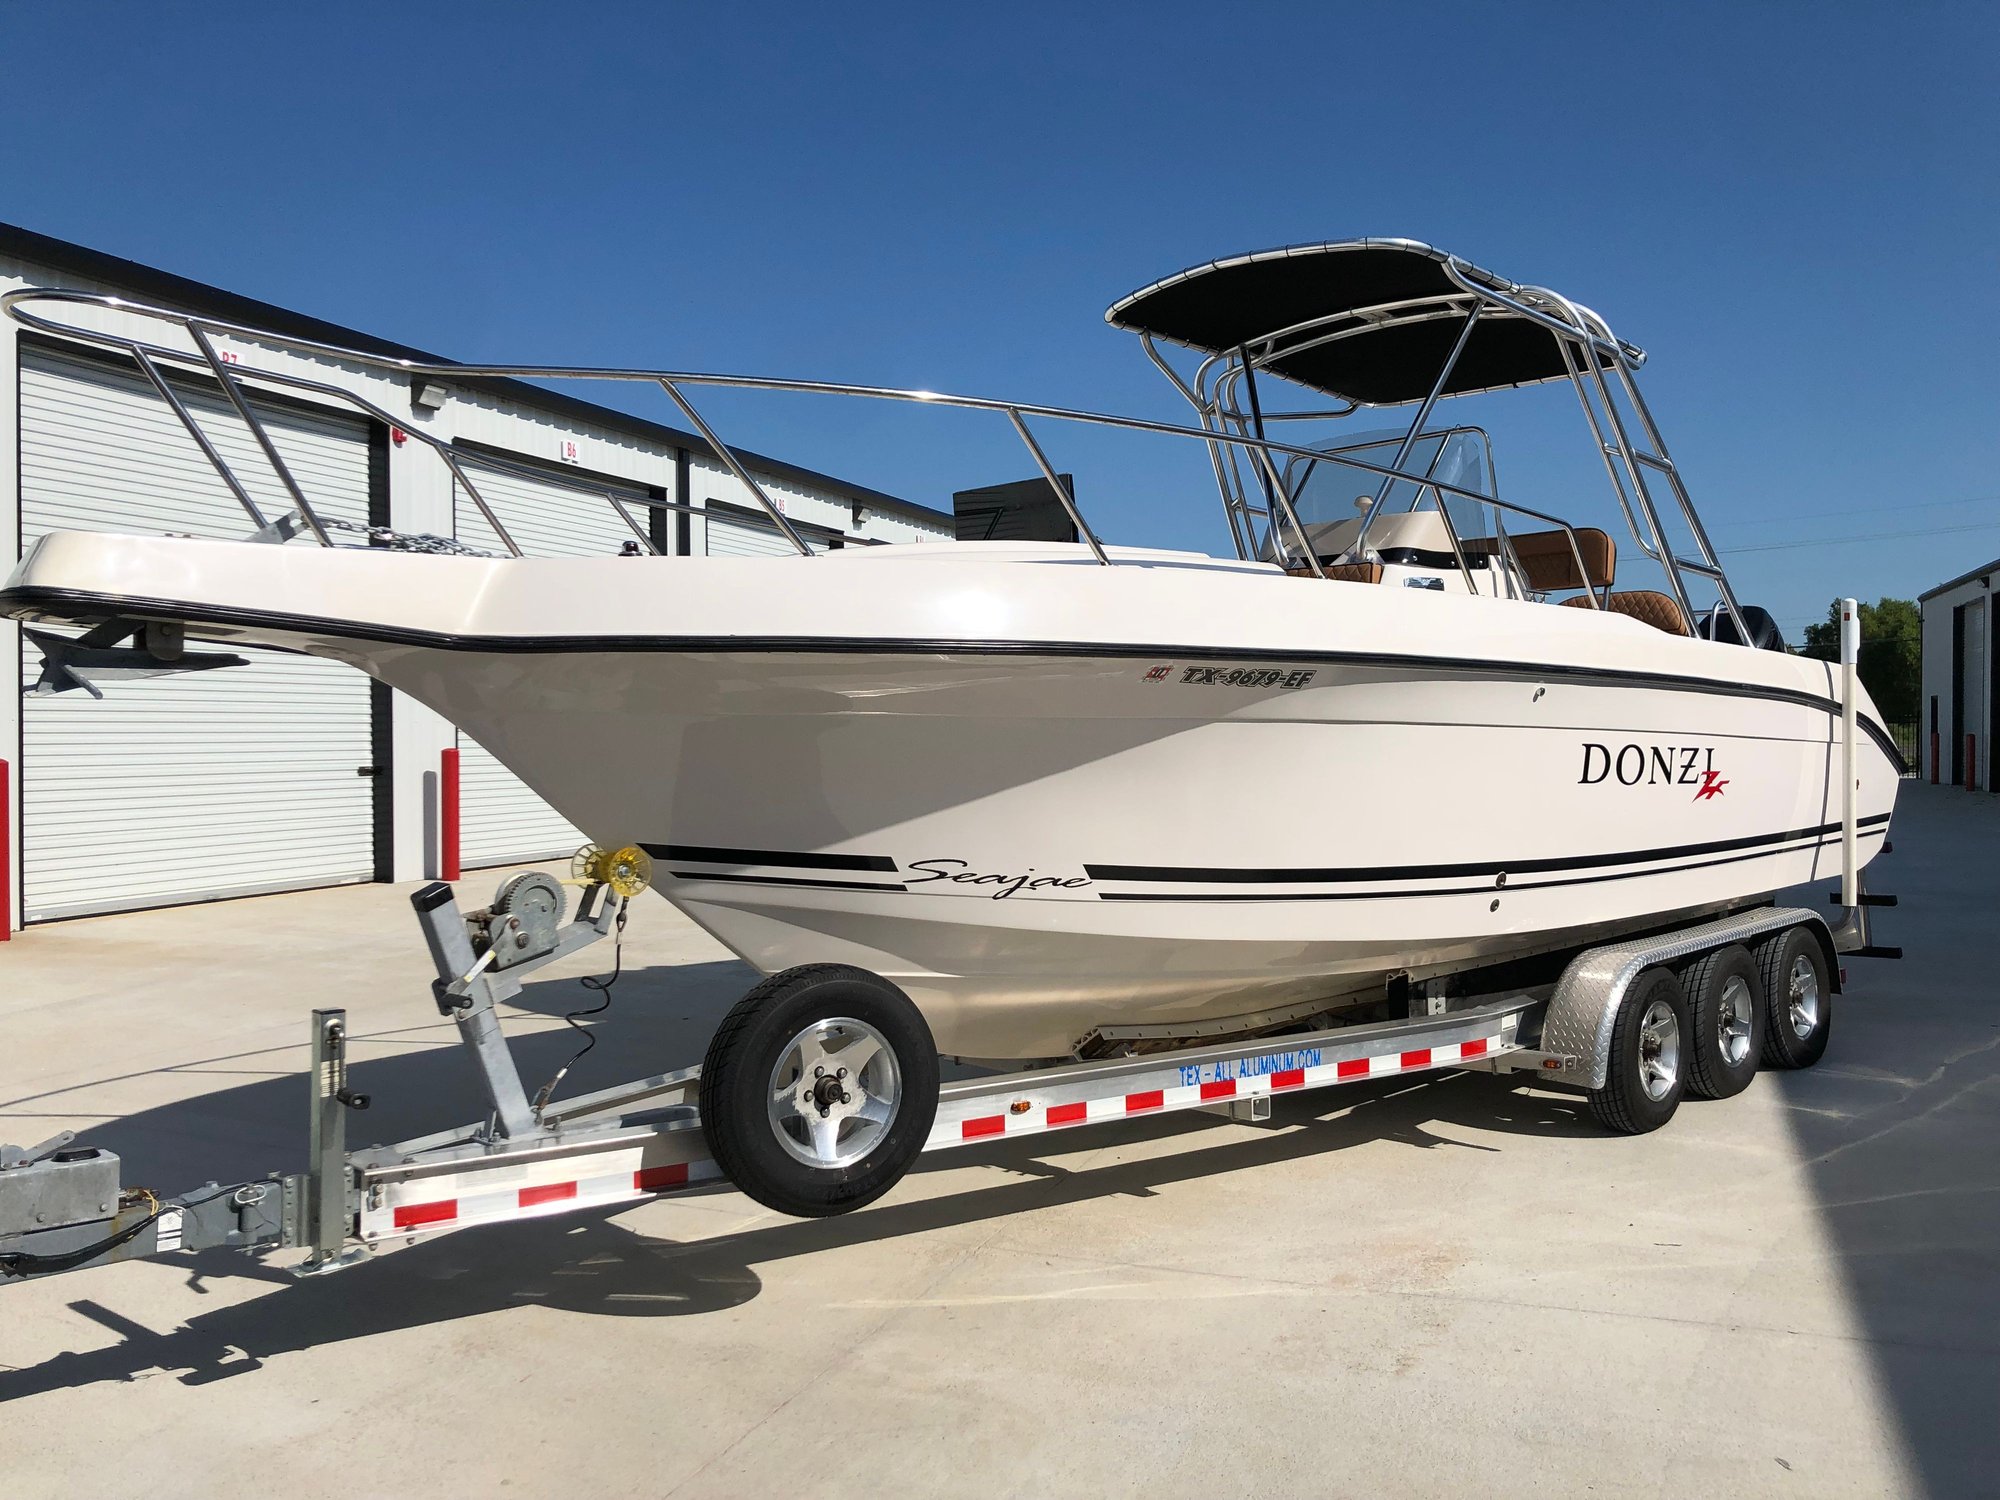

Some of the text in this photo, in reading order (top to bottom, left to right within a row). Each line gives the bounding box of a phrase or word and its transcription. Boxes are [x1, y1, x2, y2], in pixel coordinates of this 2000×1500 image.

[567, 441, 577, 458] B6
[1180, 666, 1317, 689] TX-9679-EF
[1577, 743, 1716, 786] DONZI
[902, 858, 1093, 901] Seajae
[1179, 1064, 1201, 1087] TEX
[1214, 1060, 1235, 1083] ALL
